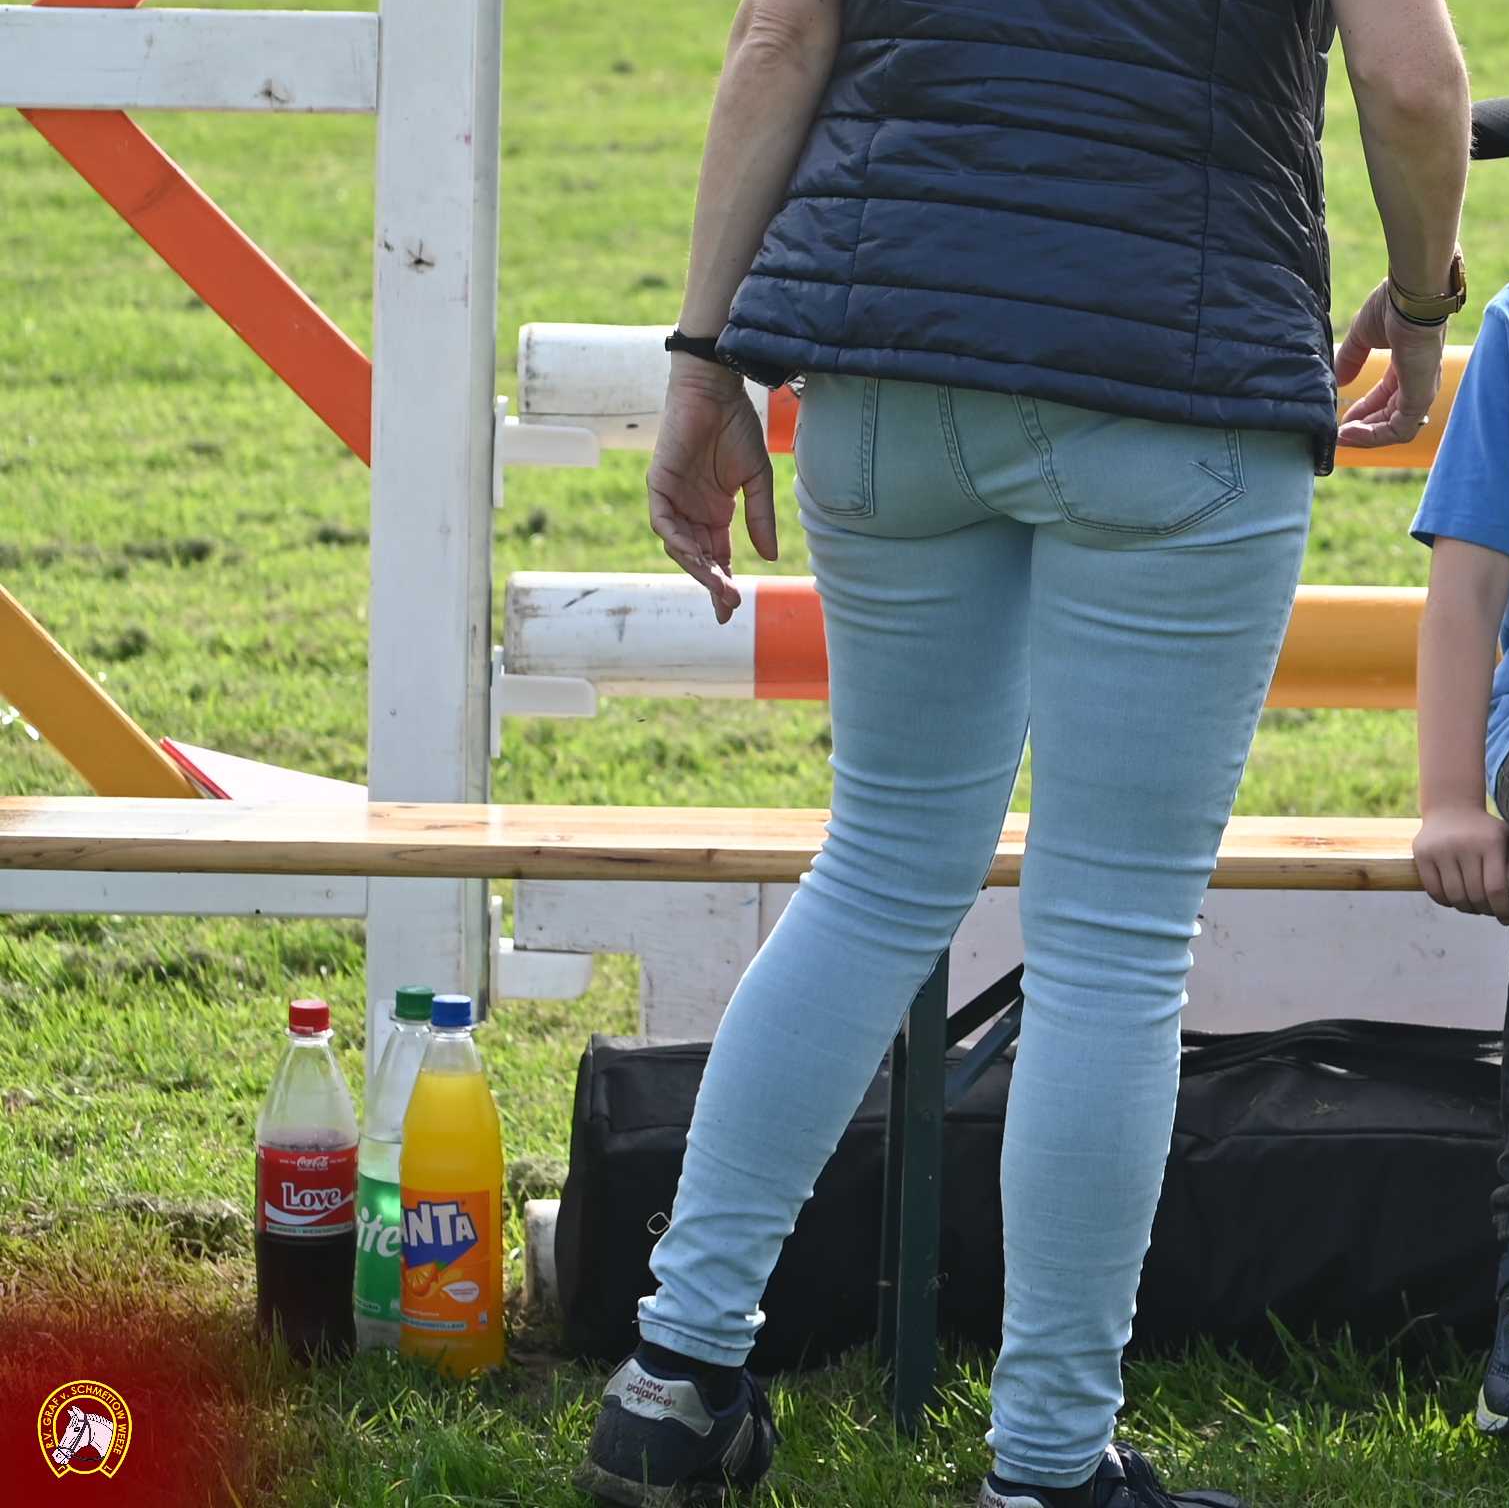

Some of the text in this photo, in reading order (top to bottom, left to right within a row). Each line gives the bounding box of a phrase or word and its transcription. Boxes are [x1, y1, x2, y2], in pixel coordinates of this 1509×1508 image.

[281, 1182, 341, 1210] Love
[626, 1382, 672, 1406] balance
[639, 1377, 665, 1392] new
